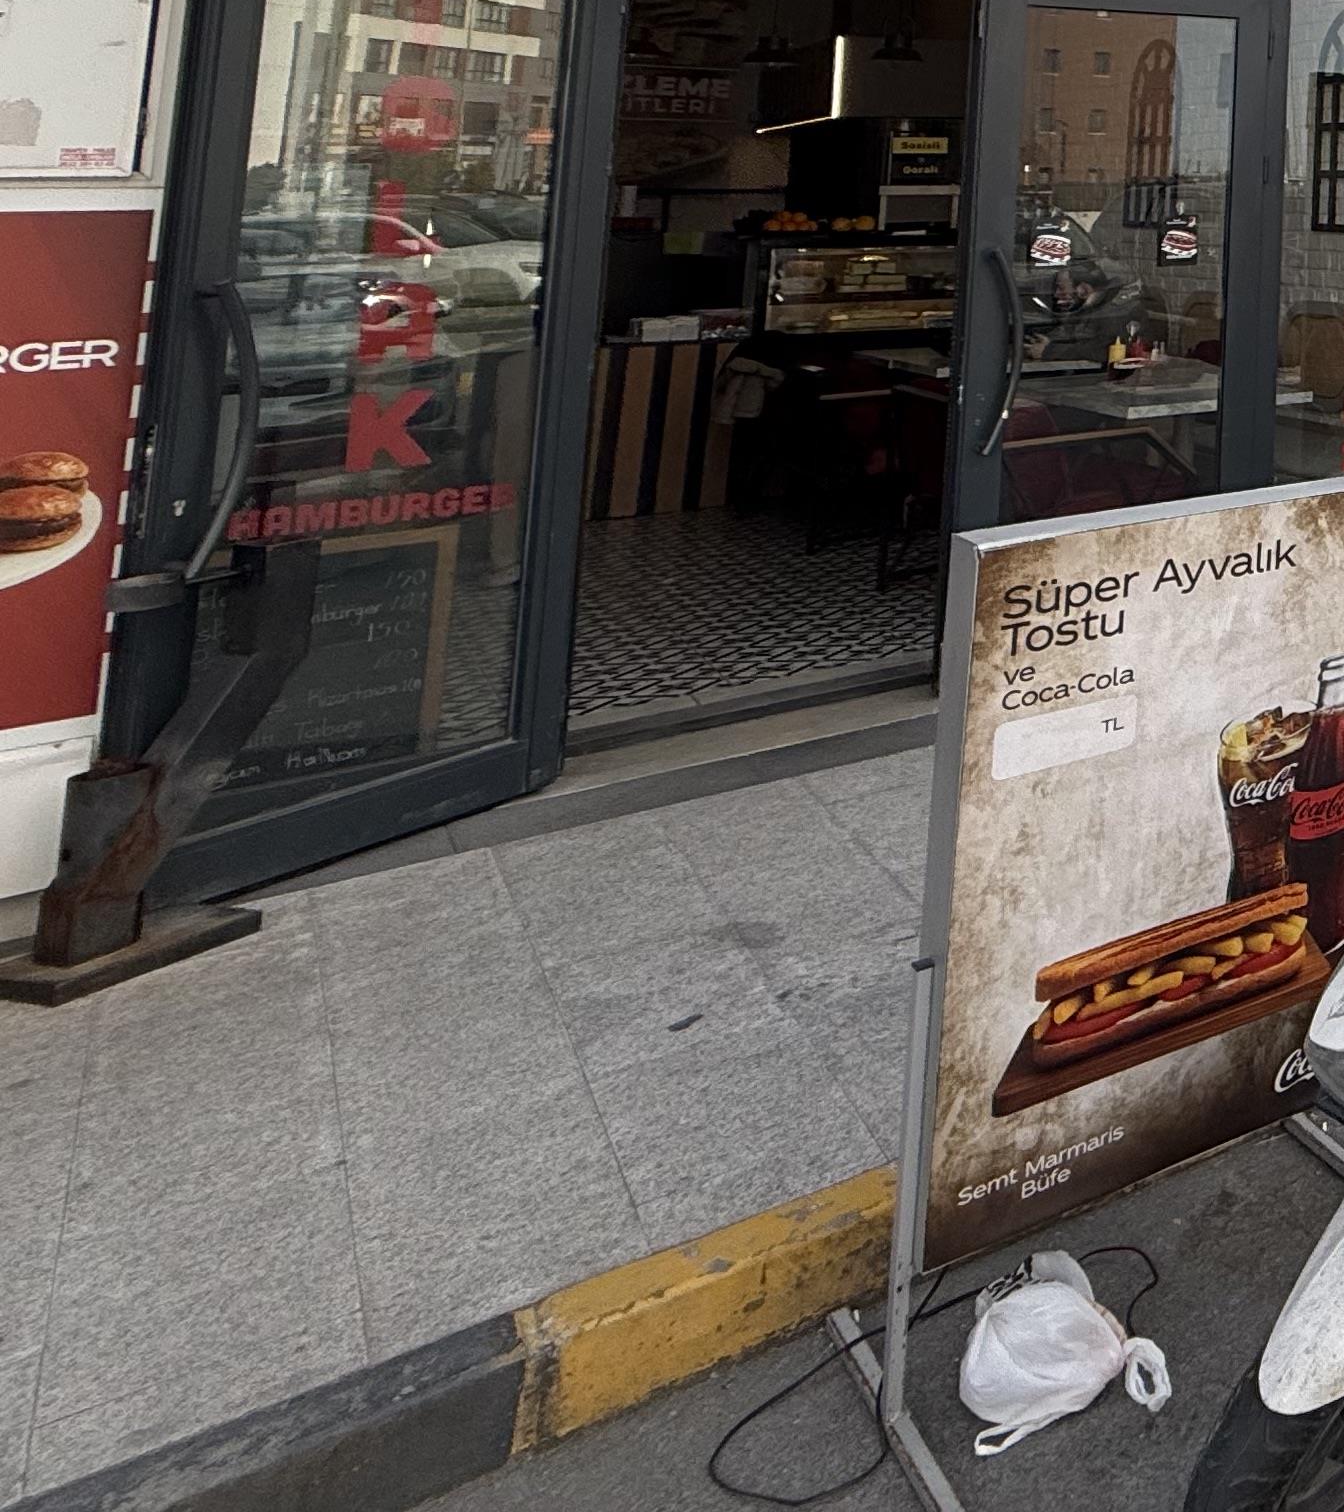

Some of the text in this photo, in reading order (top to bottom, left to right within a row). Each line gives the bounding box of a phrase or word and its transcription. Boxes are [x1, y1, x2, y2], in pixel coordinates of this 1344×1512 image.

[1002, 538, 1298, 619] Süper Ayvalık
[1001, 608, 1125, 657] Tostu
[1001, 665, 1136, 711] Coca-Cola
[1003, 664, 1036, 686] ve
[1101, 717, 1124, 734] TL
[957, 1124, 1126, 1207] Semt Marmaris
[1020, 1166, 1072, 1200] Büfe
